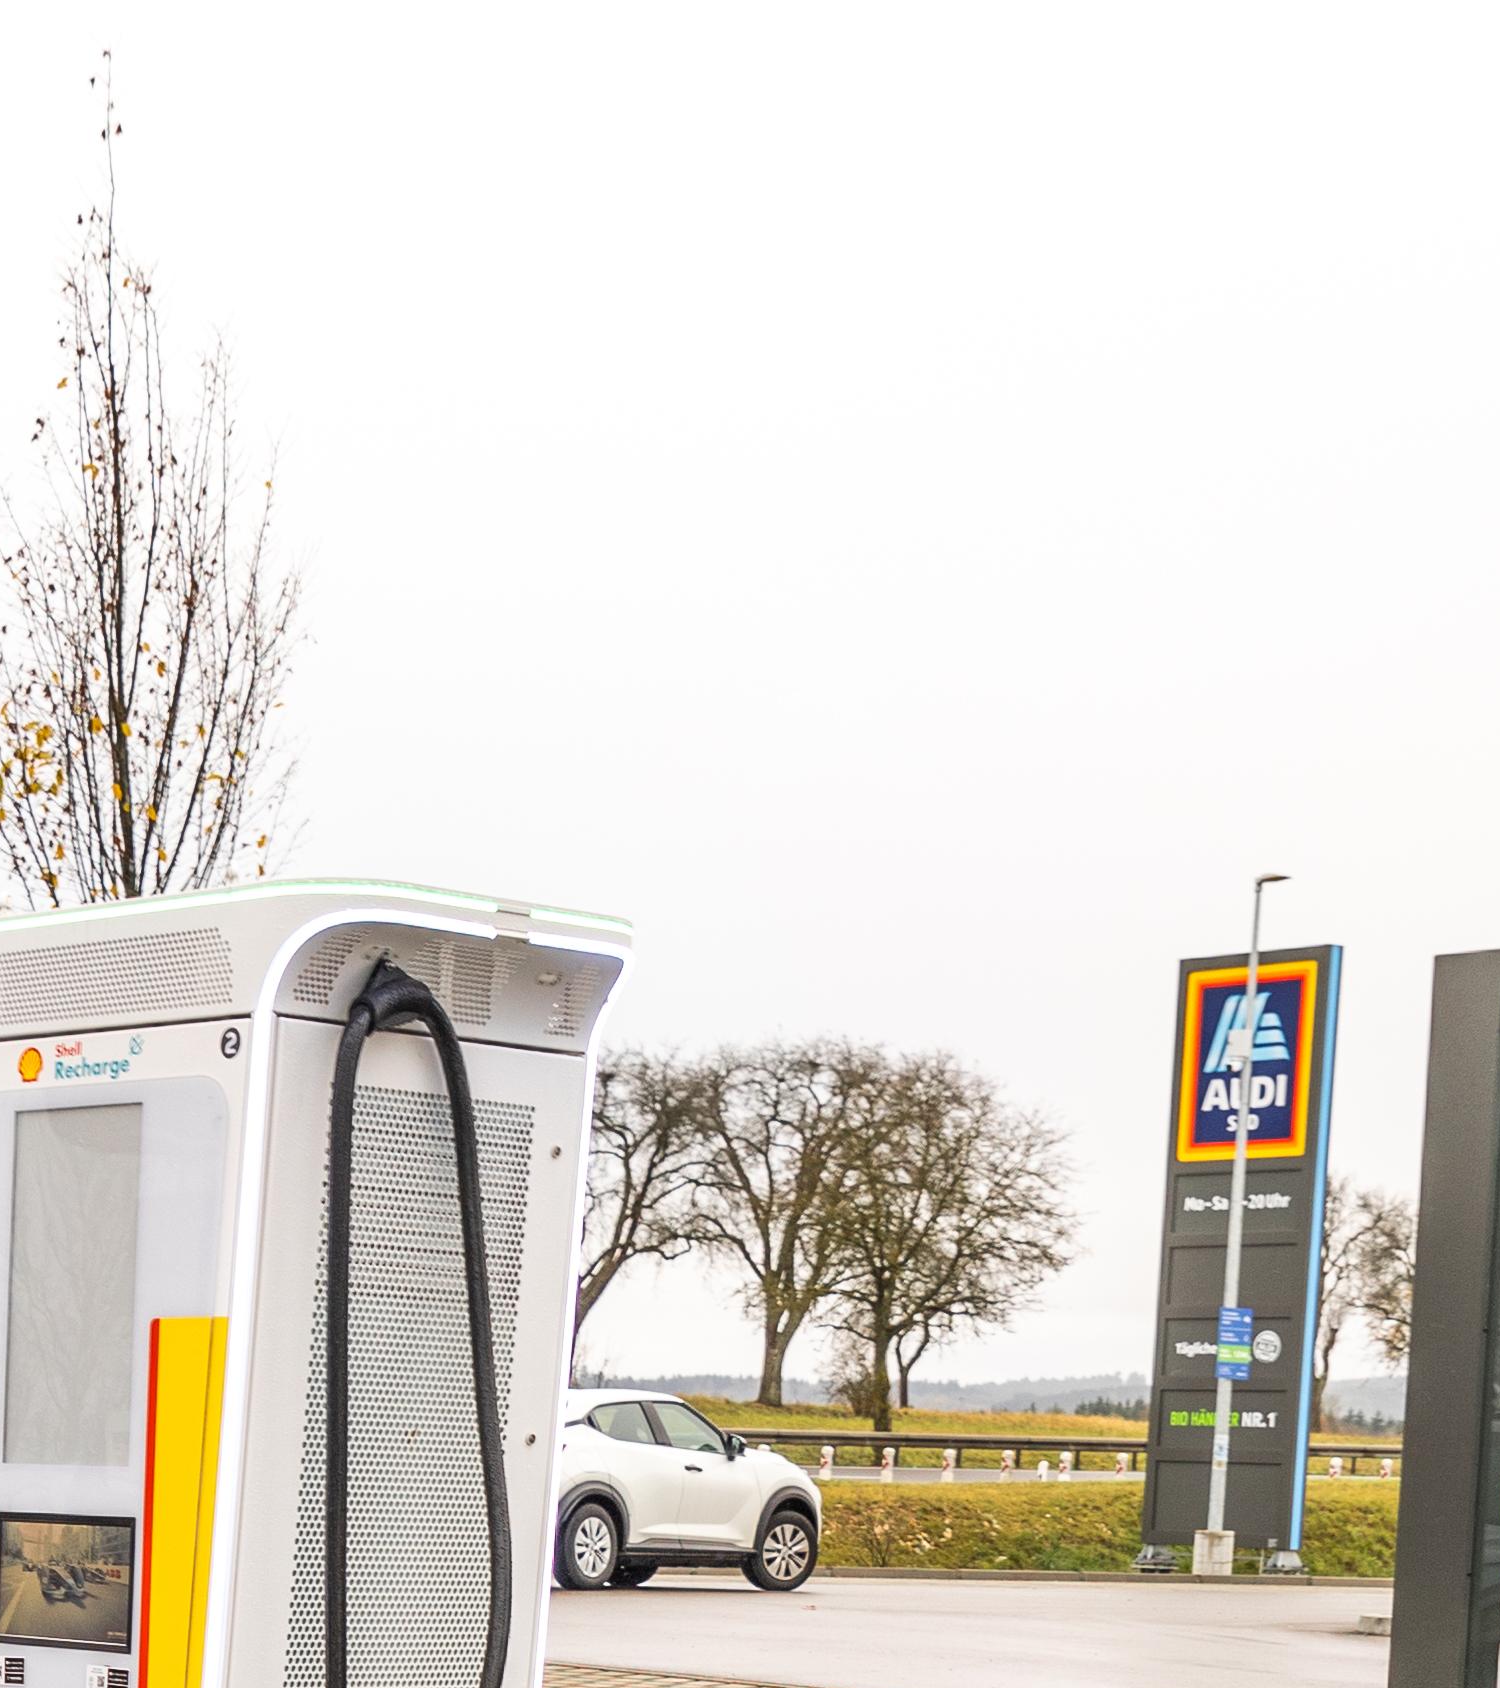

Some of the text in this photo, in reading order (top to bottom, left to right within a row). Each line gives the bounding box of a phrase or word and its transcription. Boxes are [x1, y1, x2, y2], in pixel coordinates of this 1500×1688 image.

[55, 1041, 82, 1058] Shell
[223, 1030, 240, 1056] 2
[54, 1056, 131, 1080] Recharge
[1225, 1113, 1260, 1132] SD
[1169, 1411, 1189, 1426] BIO
